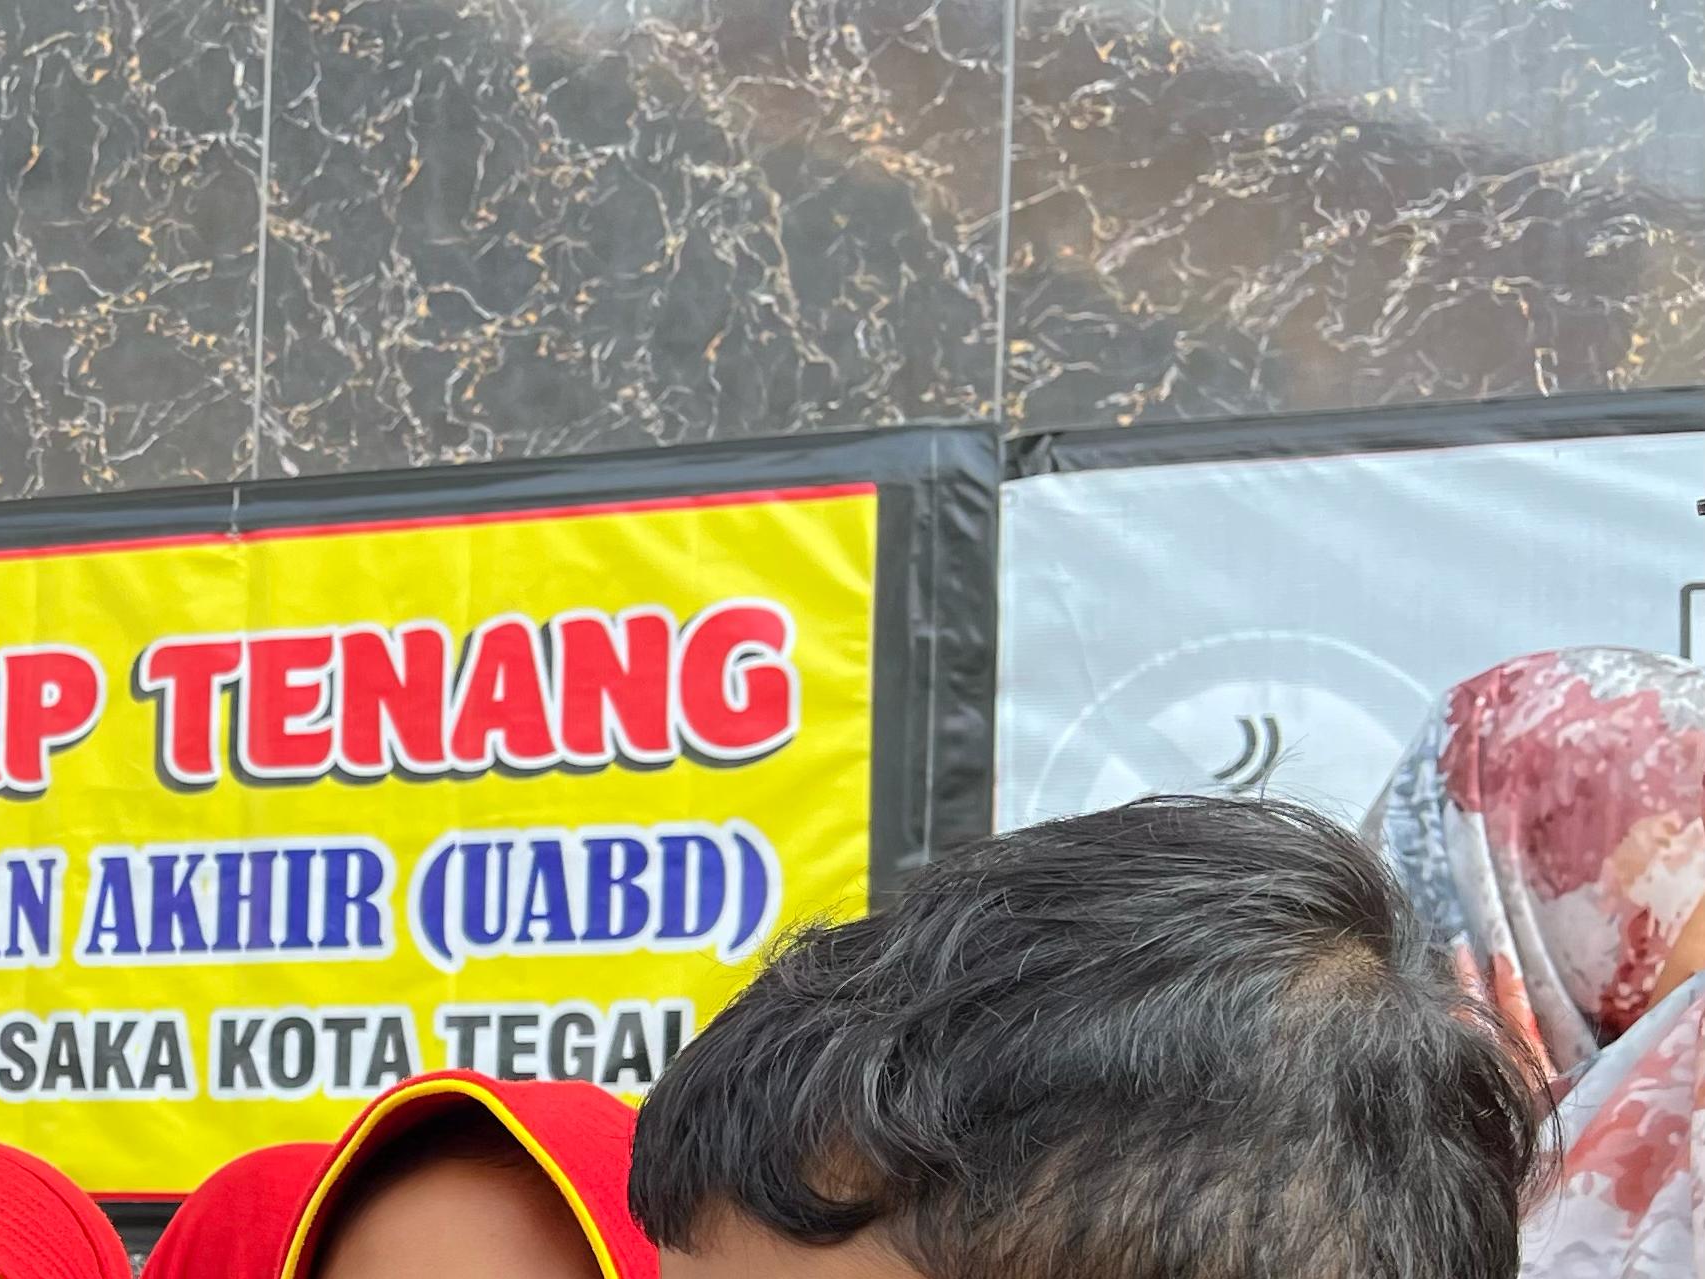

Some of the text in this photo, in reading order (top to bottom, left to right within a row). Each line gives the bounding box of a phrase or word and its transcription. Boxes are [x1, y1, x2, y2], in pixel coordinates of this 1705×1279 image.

[143, 602, 795, 782] TENANG
[84, 846, 387, 955] AKHIR
[418, 831, 772, 962] (UABD)
[218, 1012, 410, 1092] KOTA
